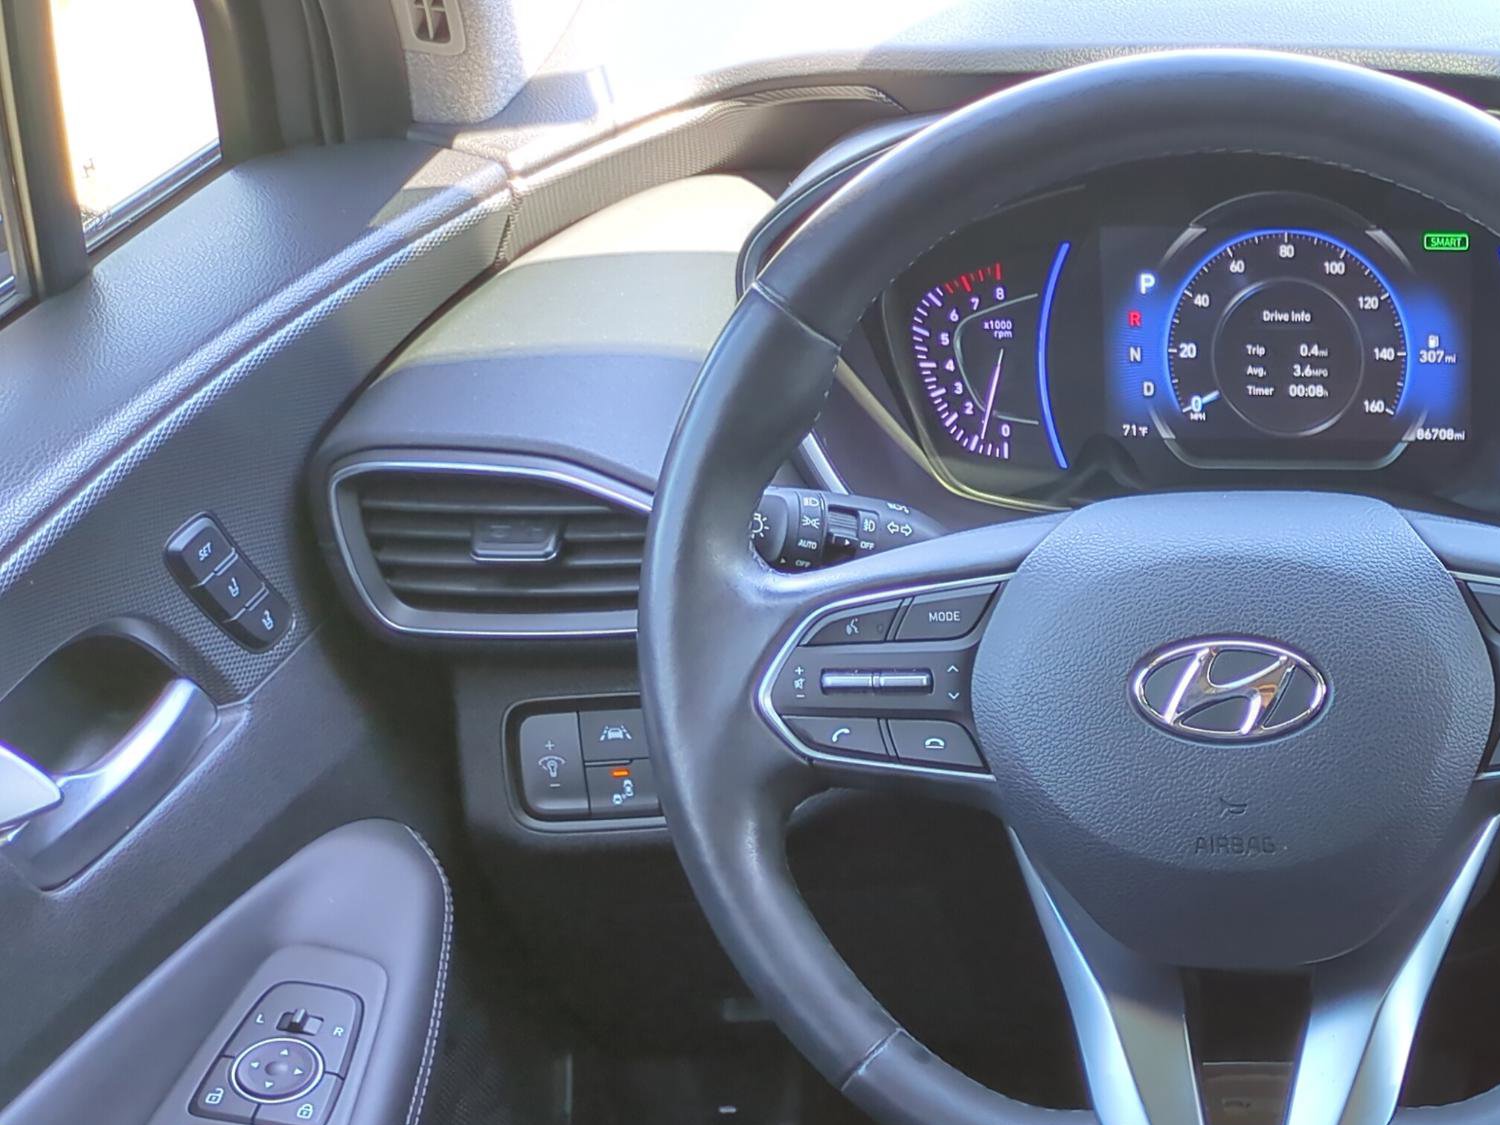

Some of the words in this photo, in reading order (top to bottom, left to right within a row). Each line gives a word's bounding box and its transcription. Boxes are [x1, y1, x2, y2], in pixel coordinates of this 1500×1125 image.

[1431, 237, 1462, 248] SMART
[1279, 245, 1295, 258] 80
[1229, 260, 1245, 273] 60
[1323, 261, 1346, 275] 100
[1139, 273, 1156, 294] P
[996, 287, 1005, 300] 8
[971, 298, 980, 311] 7
[1194, 294, 1210, 307] 40
[1358, 296, 1379, 309] 120
[950, 309, 959, 322] 6
[1128, 312, 1141, 326] R
[1263, 311, 1289, 322] Drive
[1291, 311, 1311, 322] Info
[984, 319, 1012, 331] x1000
[941, 333, 950, 346] 5
[994, 330, 1013, 340] rpm
[1130, 347, 1142, 362] N
[1179, 344, 1197, 358] 20
[1246, 345, 1266, 357] Trip
[1374, 347, 1395, 360] 140
[945, 359, 955, 372] 4
[1247, 366, 1267, 378] Avg.
[954, 382, 963, 395] 3
[1143, 382, 1155, 396] D
[1247, 386, 1274, 396] Timer
[964, 402, 973, 415] 2
[1363, 401, 1385, 413] 160
[1190, 412, 1206, 421] MPH
[1002, 424, 1011, 437] 0
[198, 542, 213, 561] SET
[798, 539, 818, 551] AUTO
[860, 541, 875, 550] OFF
[795, 559, 811, 568] OFF
[928, 611, 961, 622] MODE
[1194, 836, 1277, 855] AIRBAG
[256, 1013, 265, 1024] L
[333, 1026, 345, 1037] R
